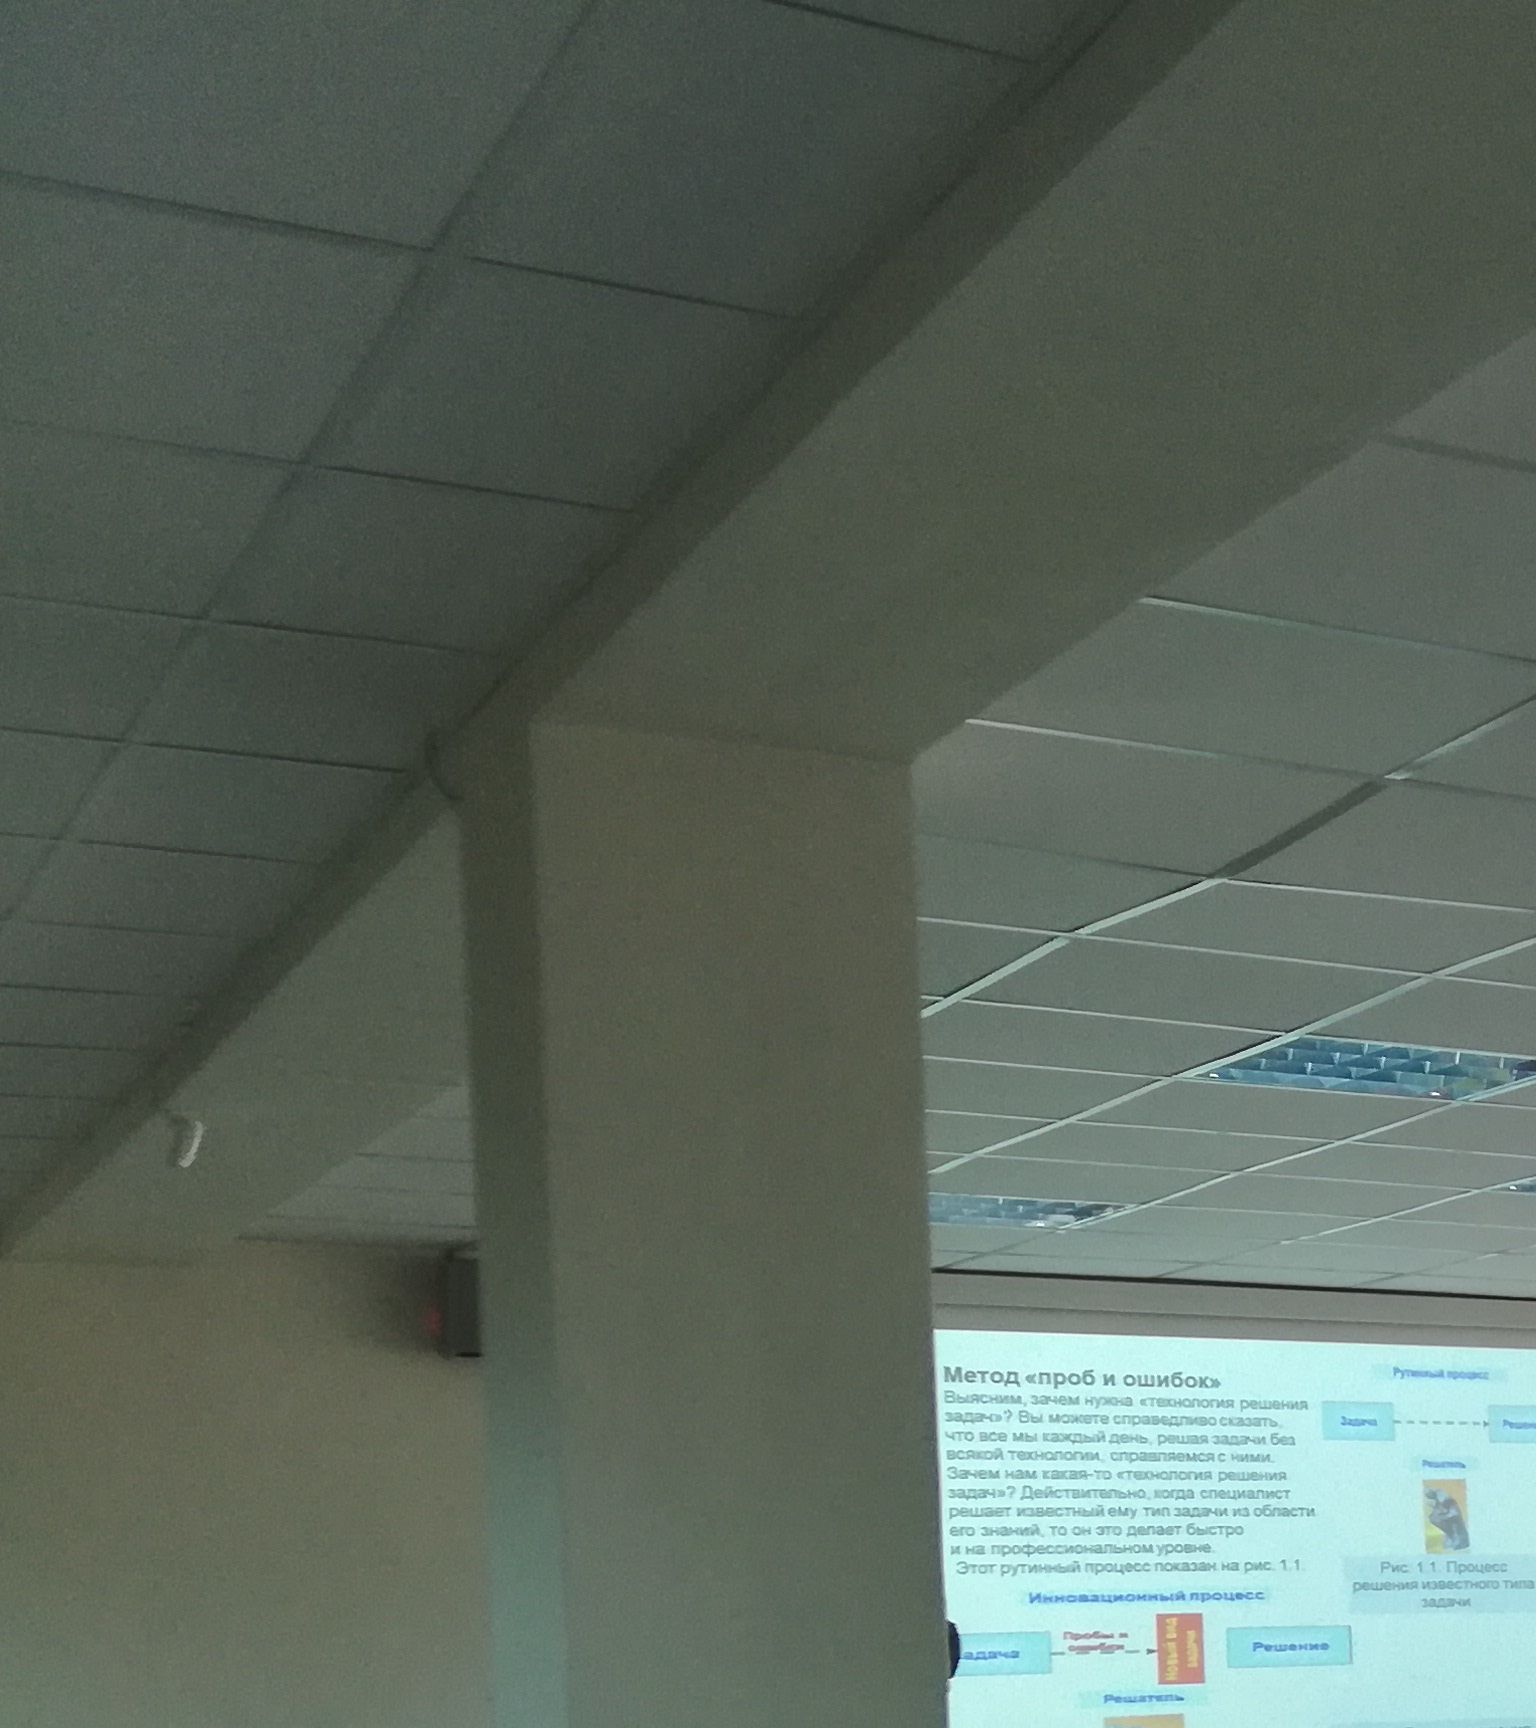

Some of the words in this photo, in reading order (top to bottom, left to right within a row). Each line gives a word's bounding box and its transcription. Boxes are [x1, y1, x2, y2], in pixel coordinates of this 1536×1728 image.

[944, 1367, 1020, 1387] Метод
[1025, 1370, 1095, 1388] «проб
[1103, 1374, 1115, 1386] и
[1123, 1372, 1221, 1388] ошибок»
[1031, 1395, 1080, 1405] зачем
[1085, 1395, 1133, 1409] нужна
[1140, 1397, 1234, 1408] «технология
[1240, 1399, 1308, 1412] решения
[1018, 1410, 1043, 1423] Вы
[1049, 1414, 1109, 1424] можете
[1113, 1415, 1217, 1427] справедливо
[945, 1431, 974, 1442] что
[979, 1431, 1007, 1442] все
[1013, 1432, 1038, 1442] мы
[1042, 1430, 1106, 1444] каждый
[1157, 1433, 1209, 1446] решая
[1211, 1434, 1267, 1446] задачи
[1270, 1432, 1296, 1446] без
[946, 1448, 1004, 1461] всякой
[1110, 1451, 1215, 1463] справляемся
[1217, 1452, 1226, 1462] с
[947, 1466, 1000, 1479] Зачем
[1005, 1470, 1037, 1479] нам
[1218, 1471, 1287, 1482] решения
[1154, 1488, 1195, 1501] когда
[1200, 1488, 1291, 1500] специалист
[949, 1506, 1011, 1519] решает
[1016, 1504, 1105, 1517] известный
[1107, 1506, 1137, 1519] ему
[1143, 1506, 1170, 1517] тип
[1174, 1506, 1229, 1518] задачи
[1232, 1506, 1250, 1517] из
[950, 1526, 975, 1537] его
[1049, 1526, 1067, 1536] то
[1071, 1526, 1091, 1536] он
[1096, 1526, 1122, 1536] это
[1126, 1525, 1182, 1537] делает
[1186, 1523, 1244, 1538] быстро
[950, 1544, 961, 1555] и
[965, 1544, 985, 1555] на
[991, 1542, 1153, 1557] профессиональном
[956, 1561, 997, 1575] Этот
[1000, 1561, 1081, 1576] рутинный
[1084, 1562, 1151, 1575] процесс
[1154, 1560, 1216, 1573] показан
[1221, 1560, 1240, 1571] на
[1446, 1560, 1508, 1575] Процесс
[1352, 1580, 1419, 1594] решения
[1422, 1580, 1499, 1590] известного
[1502, 1579, 1536, 1590] типа
[1028, 1591, 1186, 1604] Инновационный
[1190, 1591, 1266, 1603] процесс
[1420, 1597, 1472, 1609] задачи
[1251, 1641, 1331, 1652] Решение
[962, 1650, 1021, 1661] адача
[1103, 1693, 1185, 1704] Решатель
